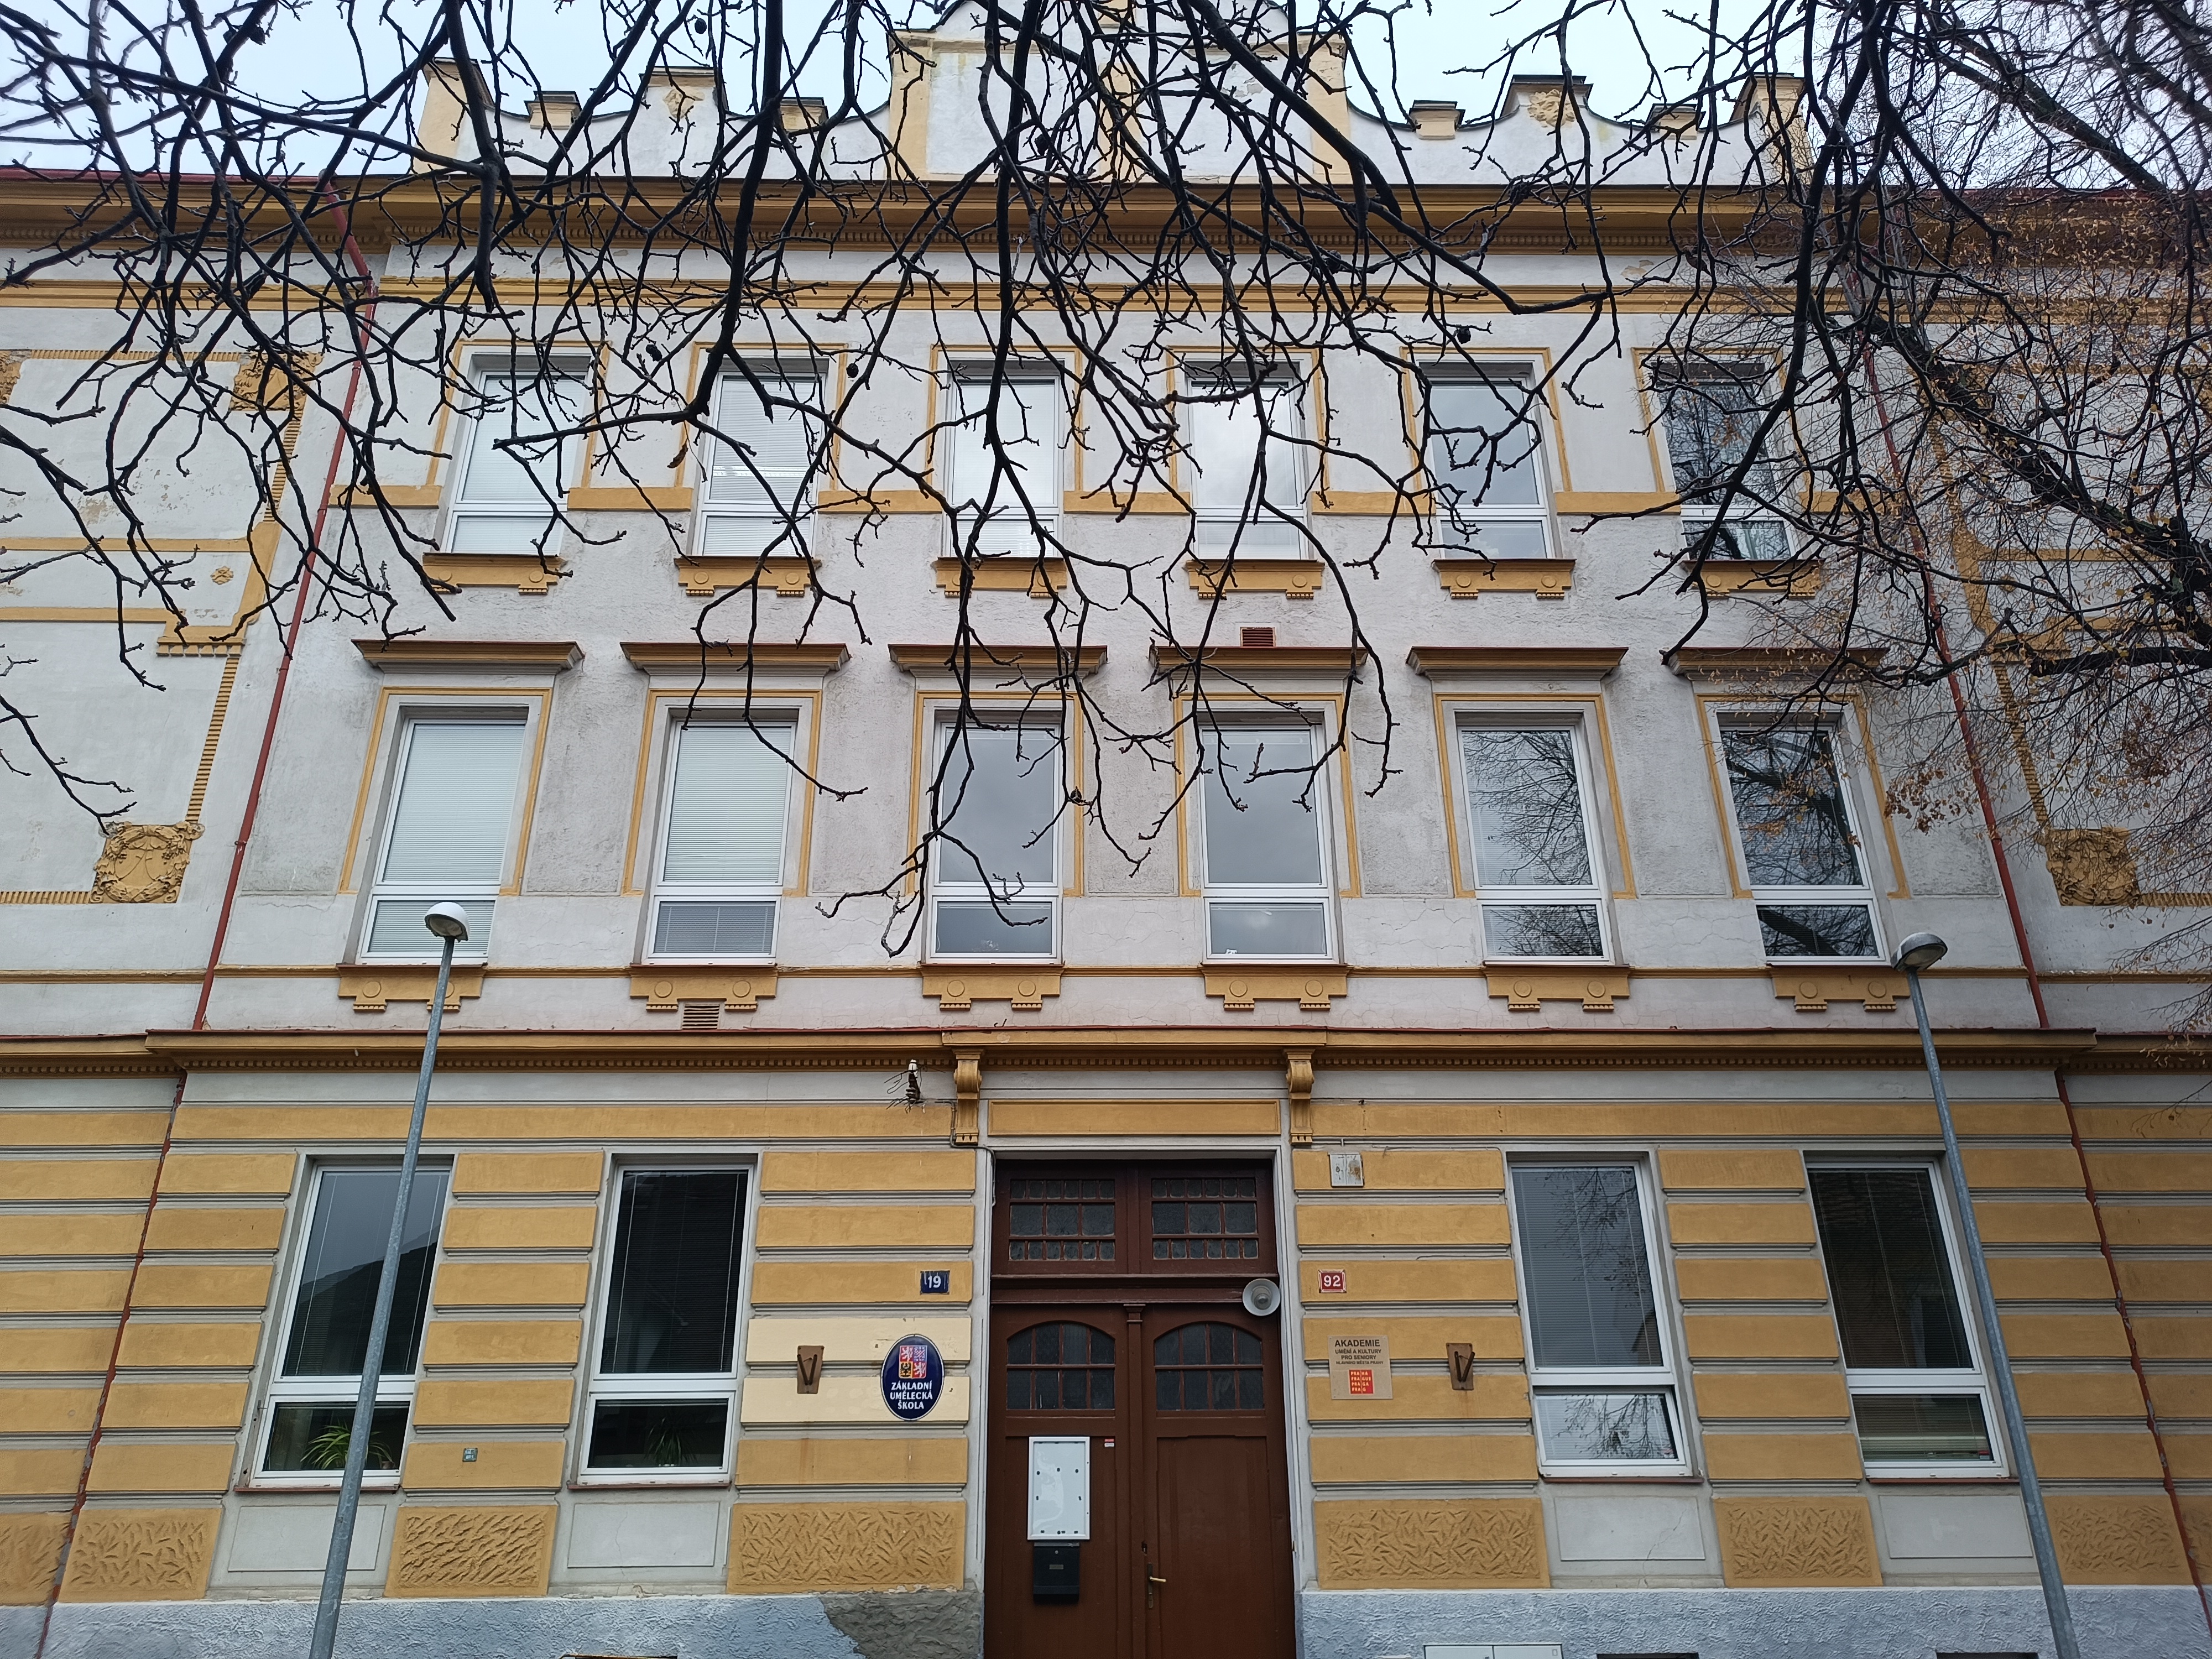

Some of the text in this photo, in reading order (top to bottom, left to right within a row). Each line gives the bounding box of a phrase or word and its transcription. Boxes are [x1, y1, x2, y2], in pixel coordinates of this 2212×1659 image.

[927, 1275, 941, 1288] 19
[1323, 1275, 1341, 1287] 92
[891, 1380, 932, 1390] ZÁKLADNÍ
[890, 1390, 933, 1400] UMĚLECKÁ
[898, 1400, 925, 1410] ŠKOLA
